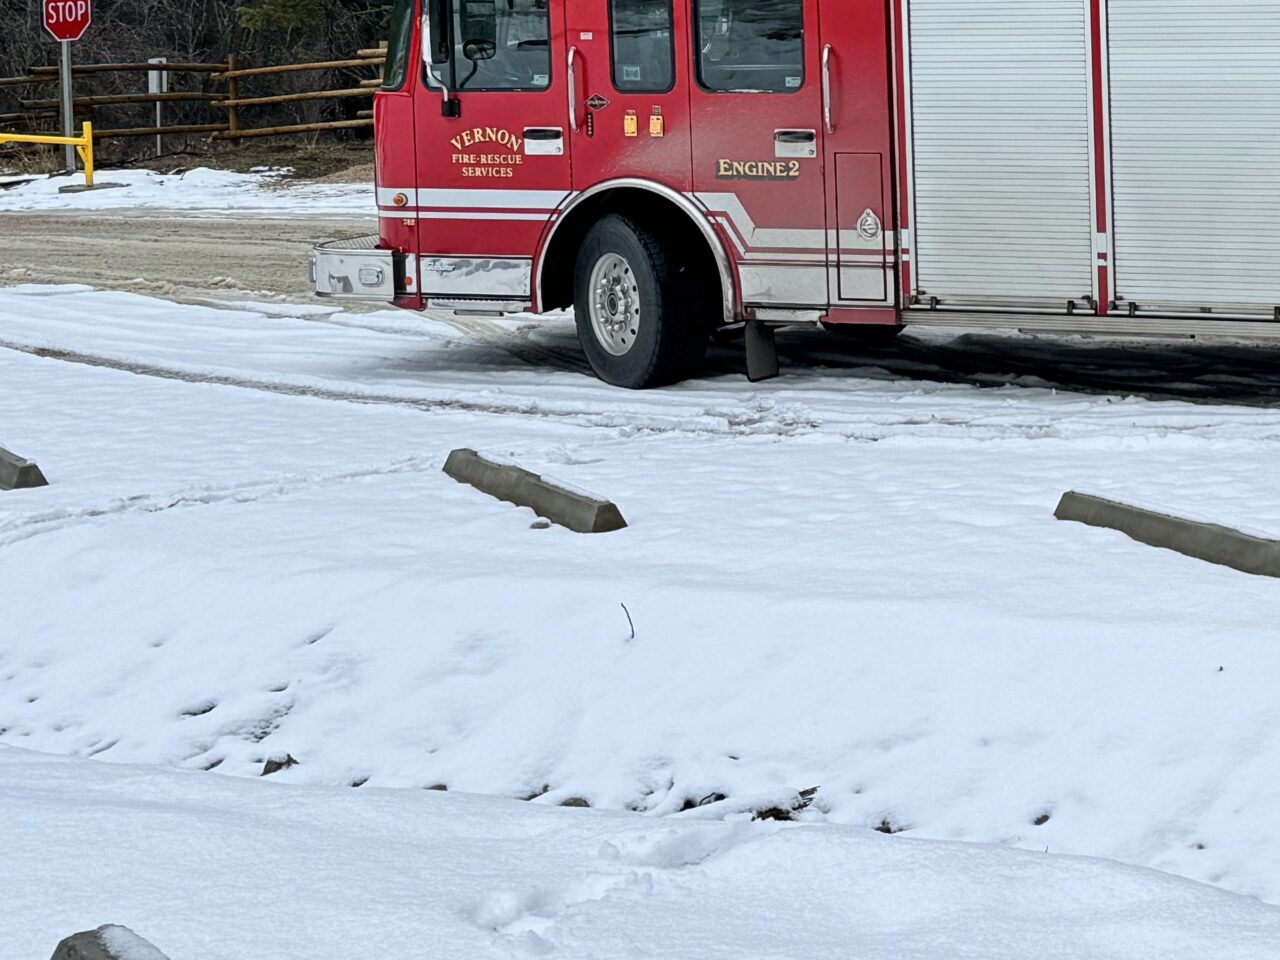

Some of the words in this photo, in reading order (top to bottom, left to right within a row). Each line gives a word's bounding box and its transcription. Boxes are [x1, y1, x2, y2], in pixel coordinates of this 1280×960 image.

[48, 0, 86, 23] STOP
[450, 127, 522, 152] VERNON
[462, 167, 513, 177] SERVICES
